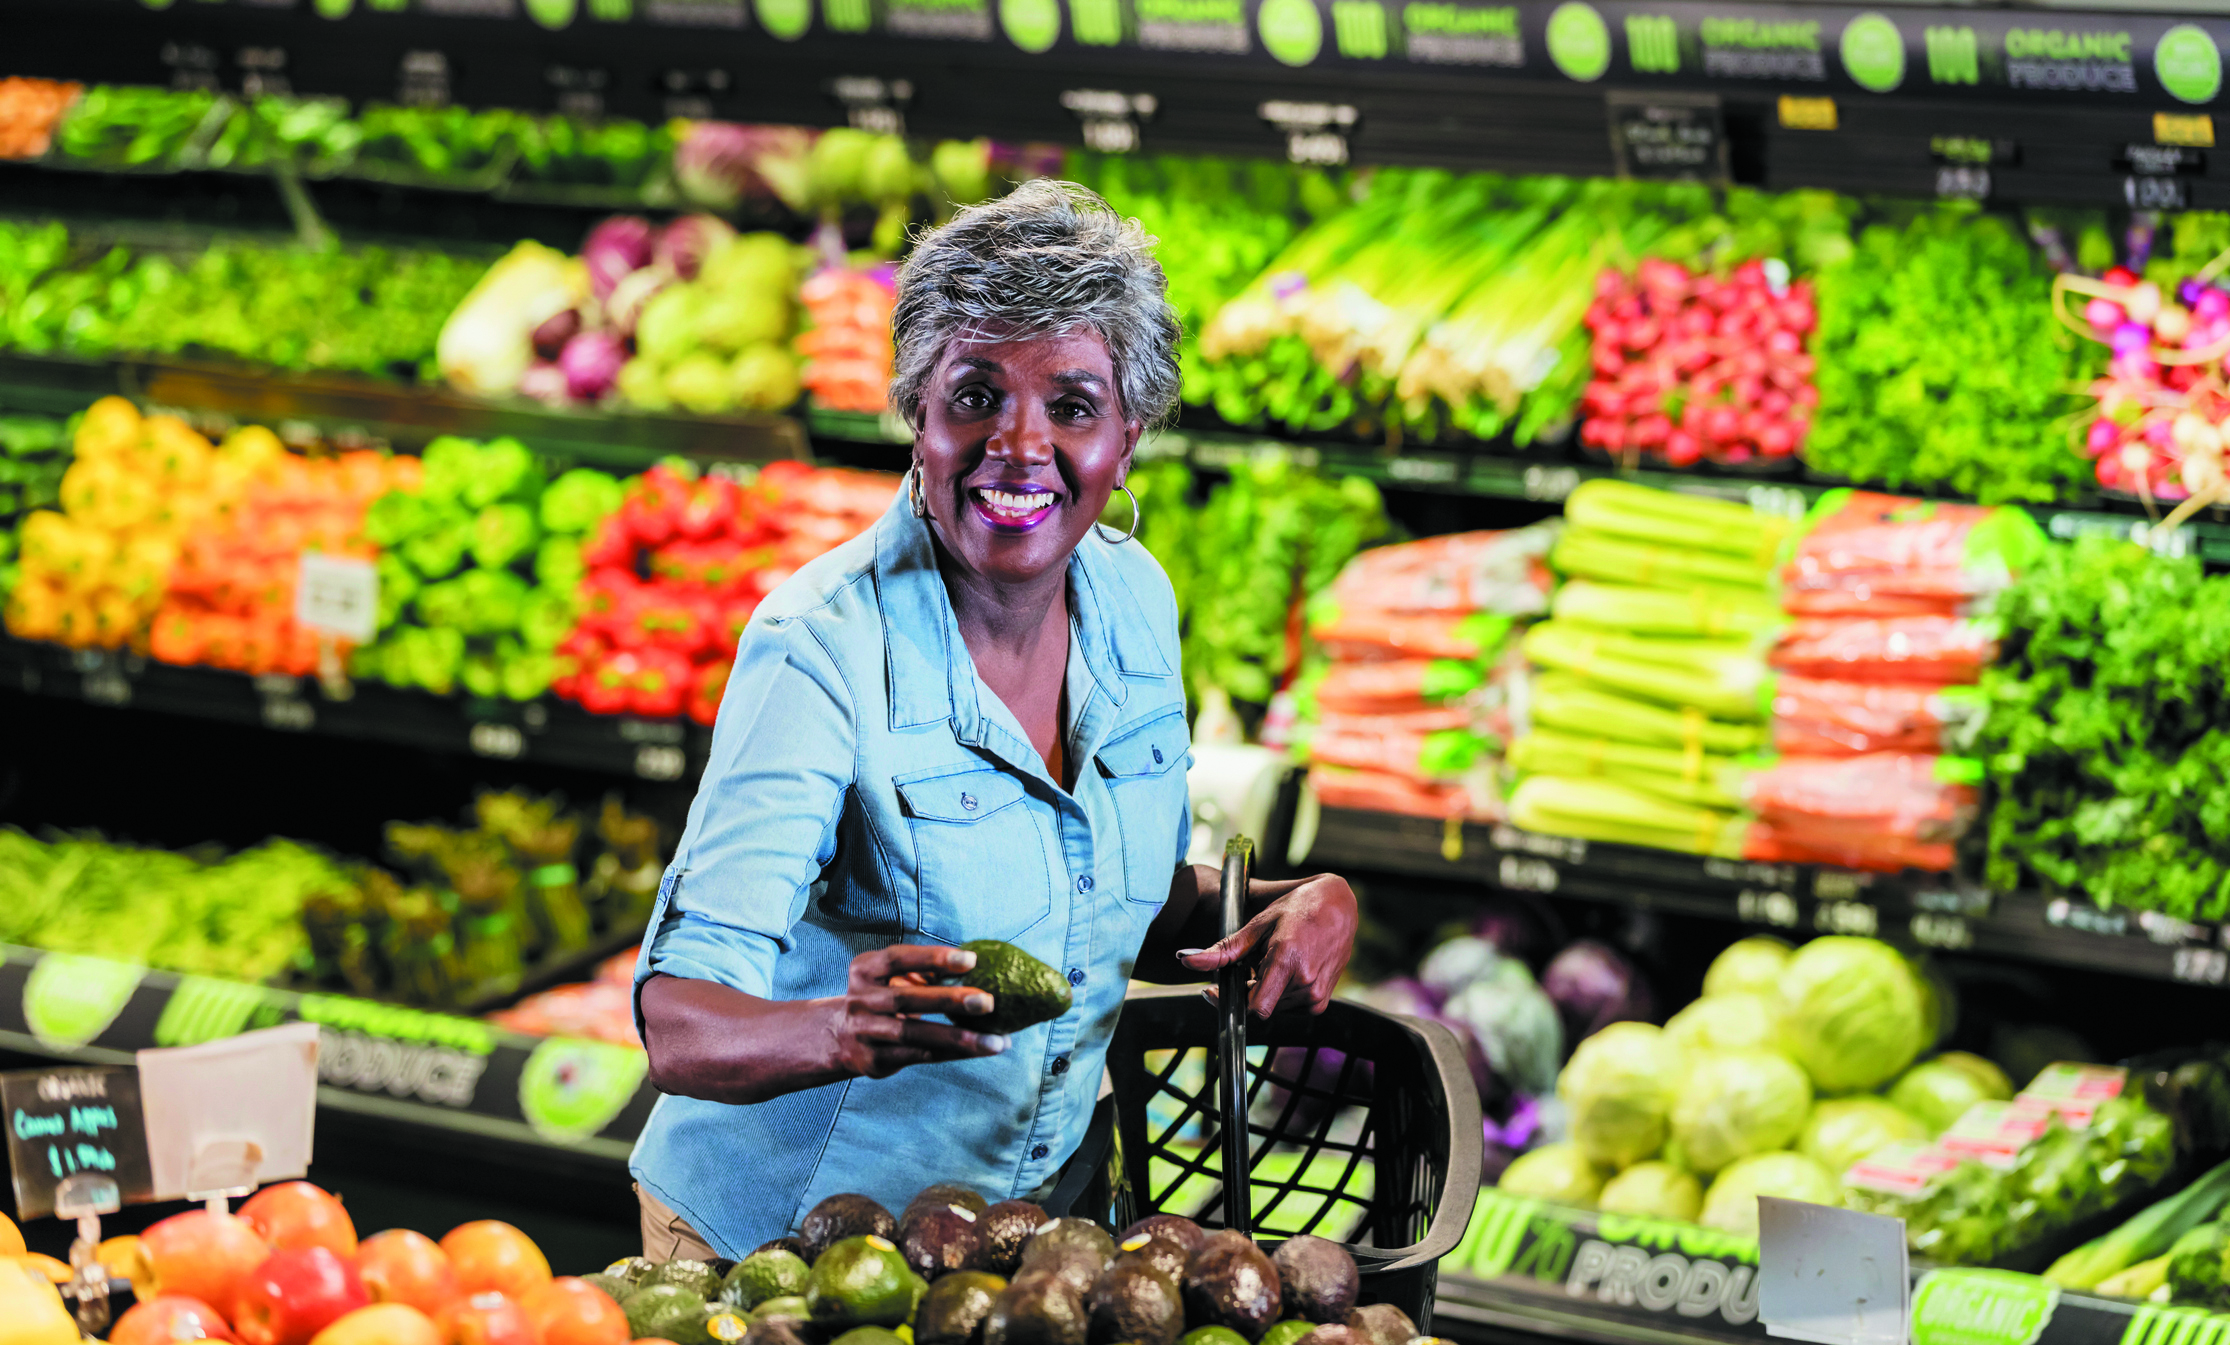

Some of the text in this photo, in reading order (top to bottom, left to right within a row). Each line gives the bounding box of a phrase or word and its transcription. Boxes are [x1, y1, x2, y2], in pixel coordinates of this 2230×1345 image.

[2005, 27, 2132, 62] ORGANIC
[2006, 58, 2138, 93] PRODUCE
[1565, 1239, 1759, 1325] PRODU
[1921, 1284, 2039, 1339] ORGANIC
